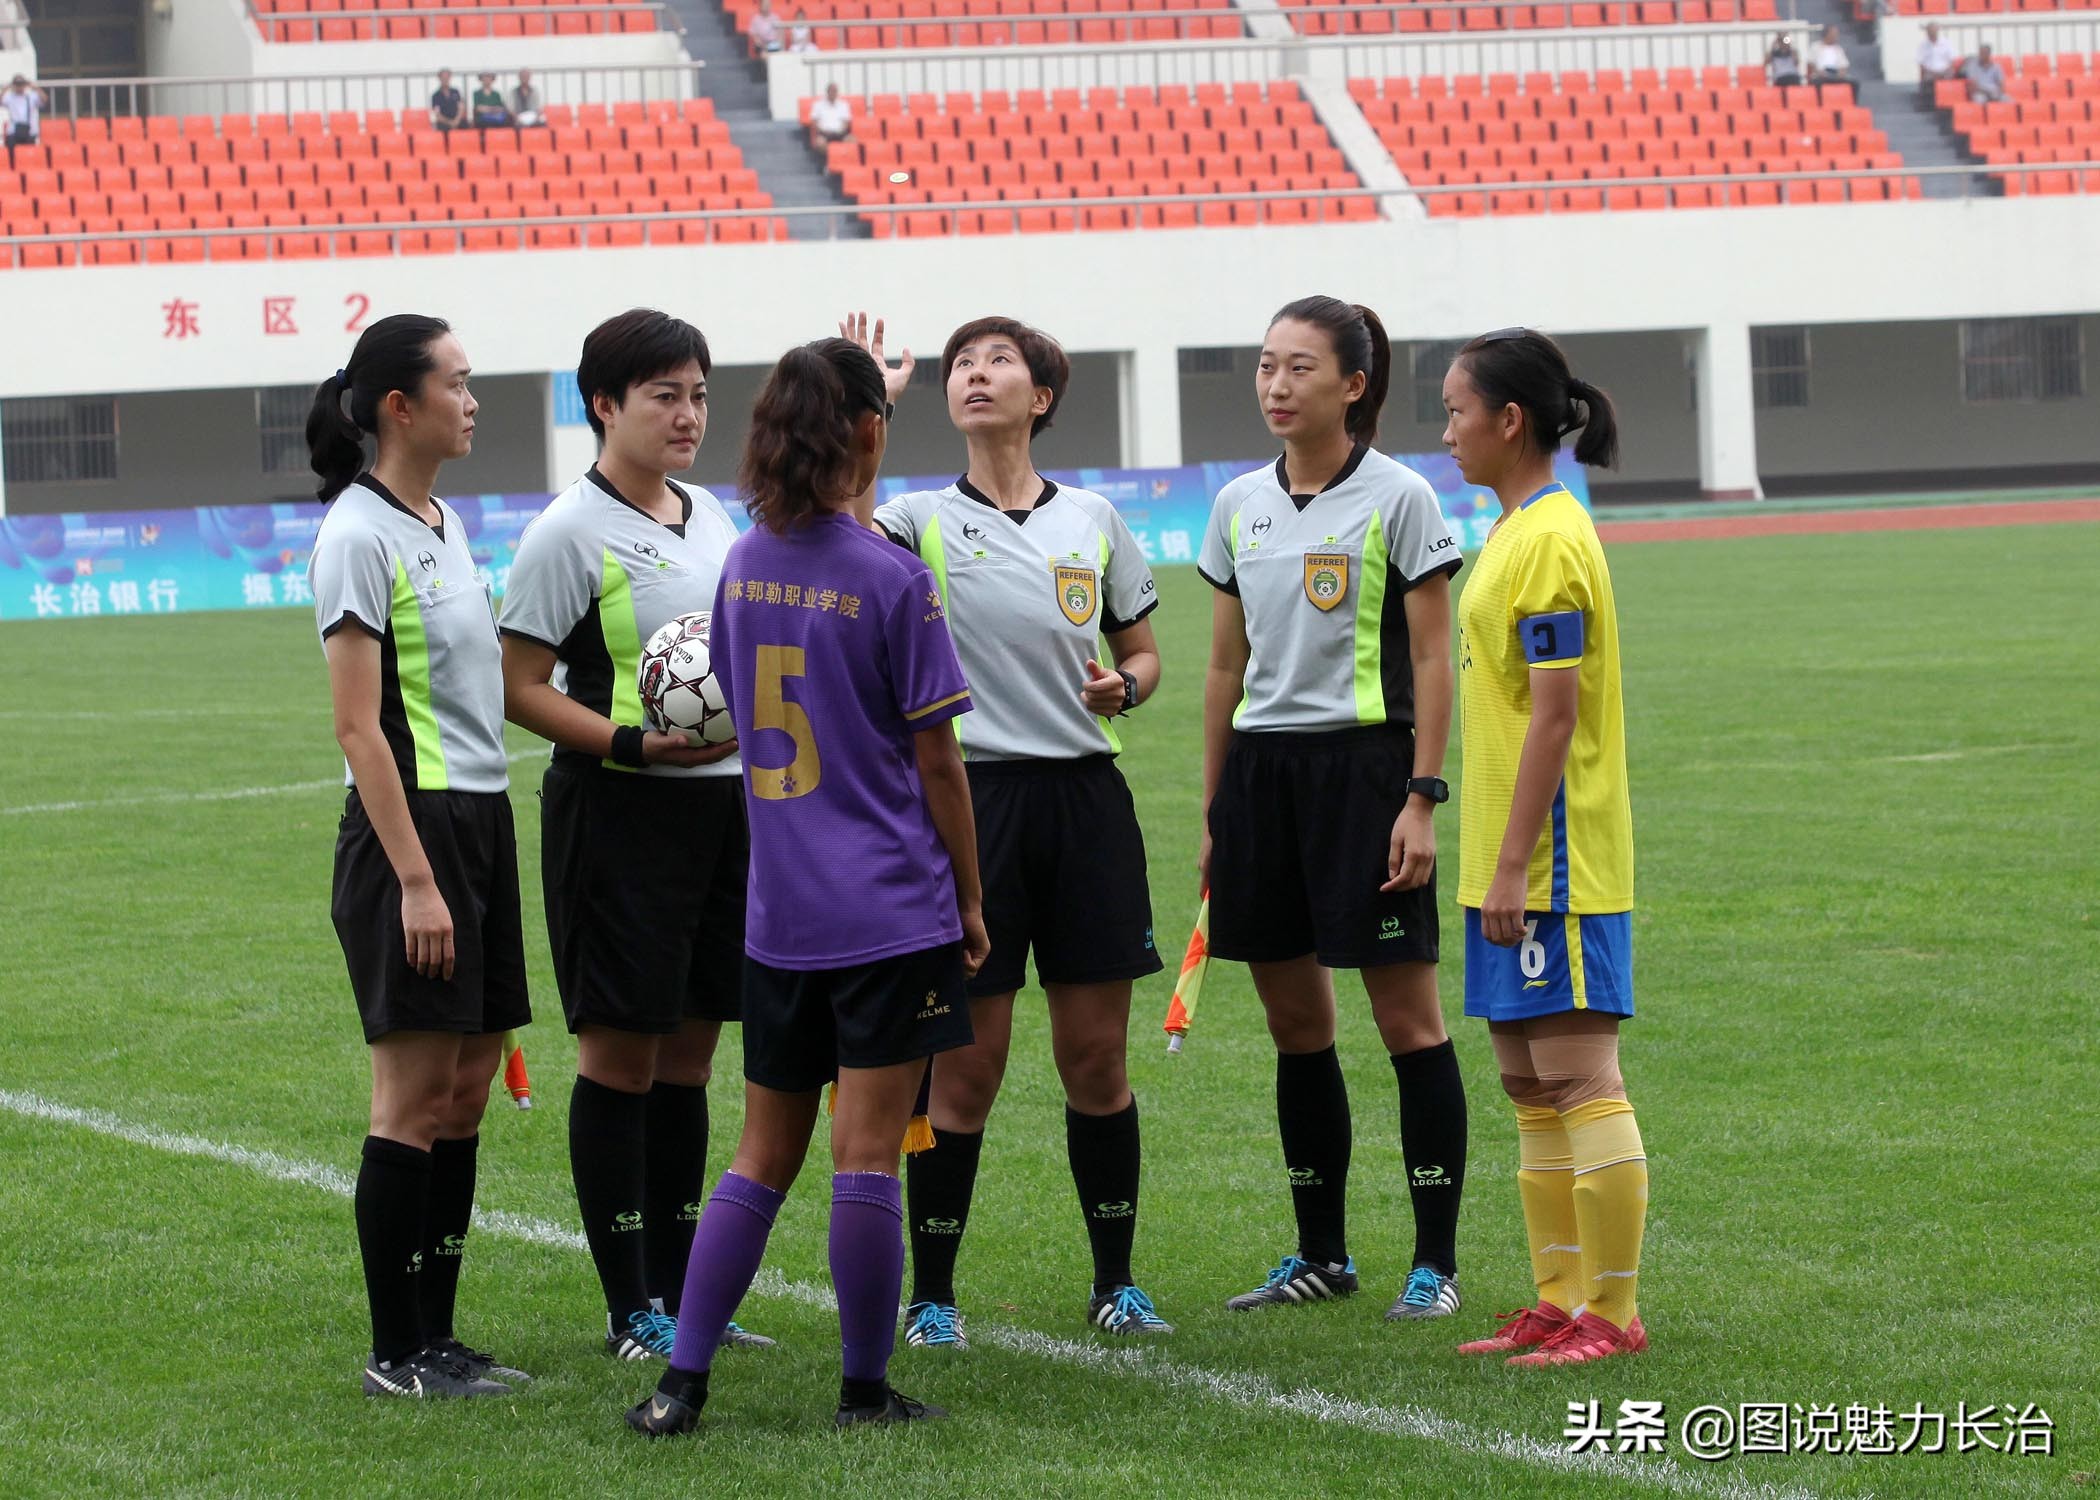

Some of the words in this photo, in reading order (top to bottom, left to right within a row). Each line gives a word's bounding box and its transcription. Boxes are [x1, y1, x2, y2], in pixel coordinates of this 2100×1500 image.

[1308, 558, 1345, 566] REFEREE
[1060, 571, 1093, 581] REFEREE
[30, 579, 178, 616] 长治银行
[750, 644, 822, 800] 5
[1378, 929, 1405, 940] LOOKS
[1520, 919, 1546, 978] 6
[1412, 1177, 1451, 1186] LOOKS
[1093, 1209, 1134, 1218] LOOKS
